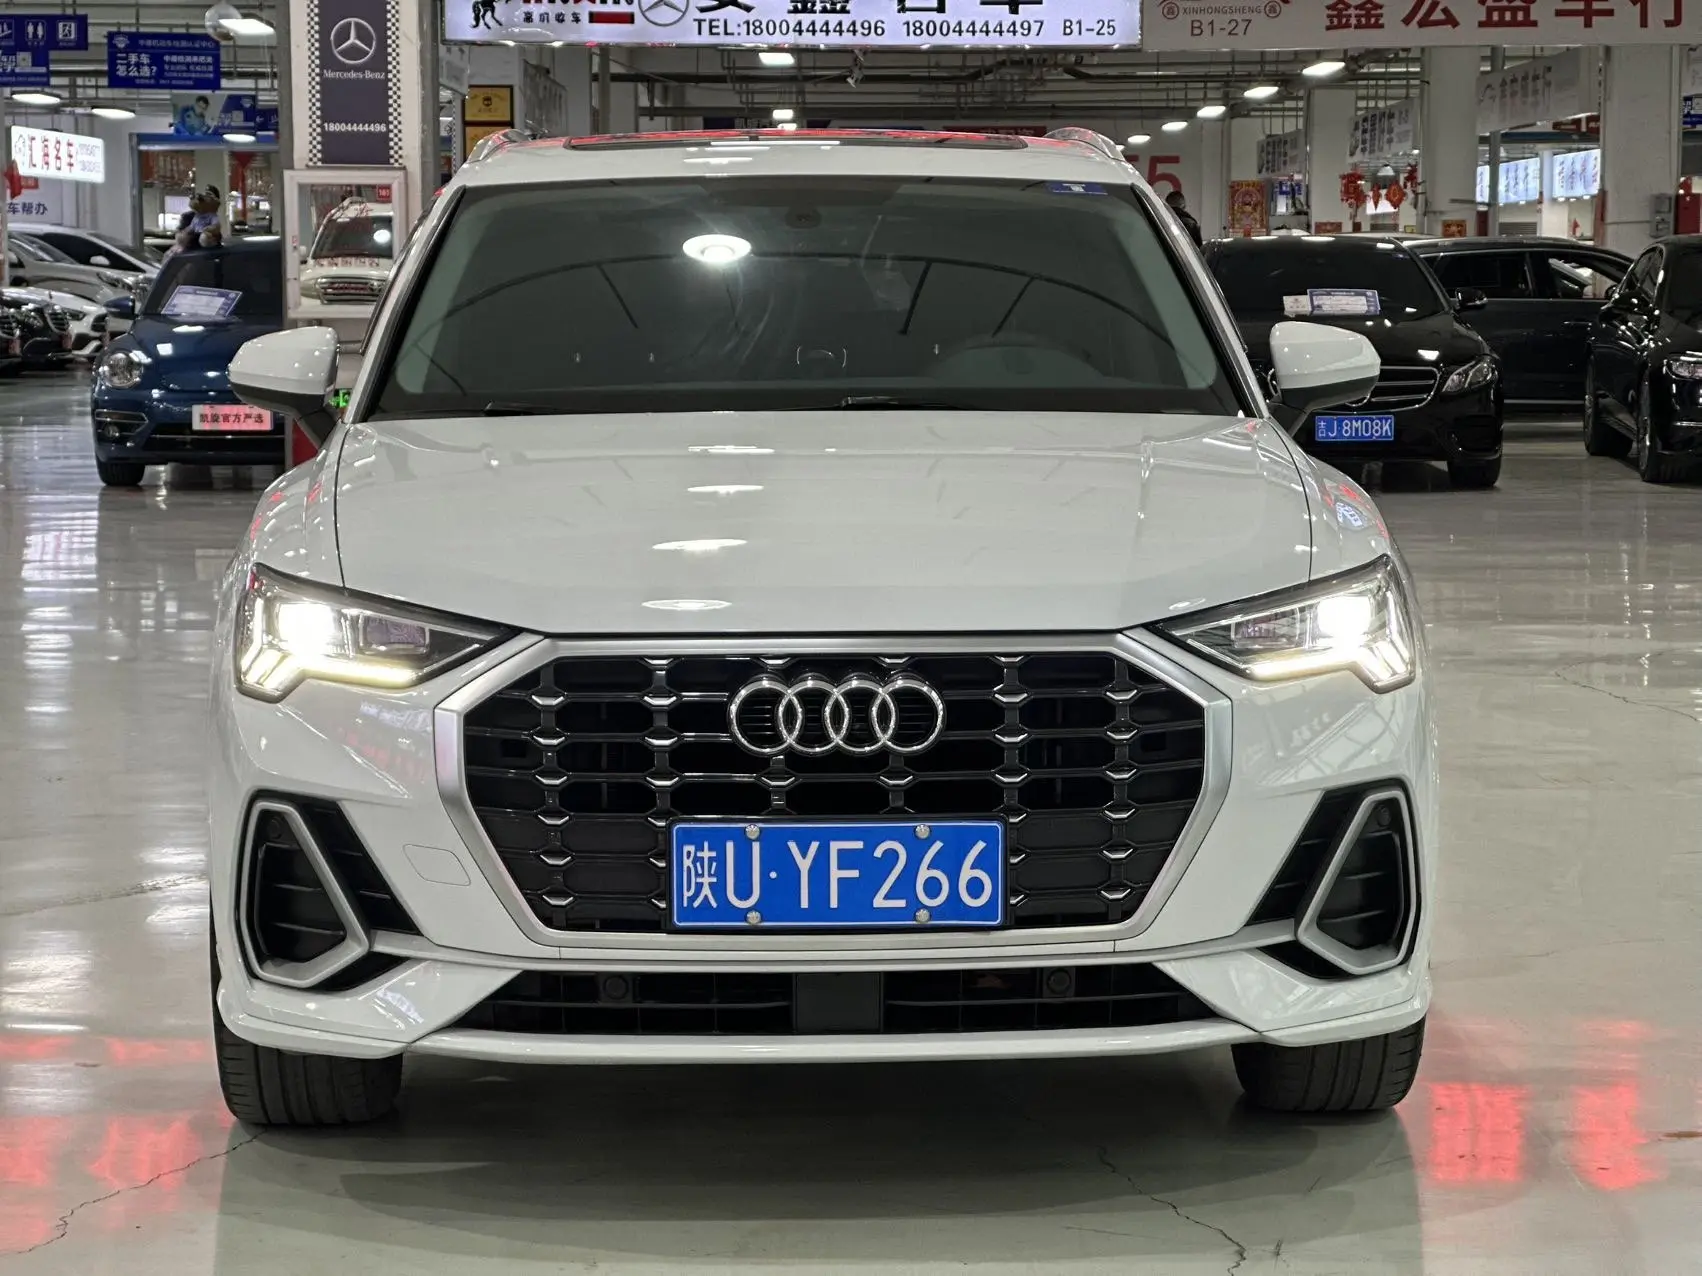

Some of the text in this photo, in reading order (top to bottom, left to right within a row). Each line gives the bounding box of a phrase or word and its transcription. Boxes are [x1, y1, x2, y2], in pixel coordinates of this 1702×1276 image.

[1182, 6, 1262, 16] XINHONGSHENG
[693, 18, 1116, 37] TEL:18004444496 18004444497 B1-25
[1190, 19, 1252, 37] B1-27
[116, 53, 151, 65] 二手车
[323, 69, 386, 80] Mercedes-Benz
[323, 122, 387, 132] 18004444496
[27, 133, 75, 173] 汇海名车
